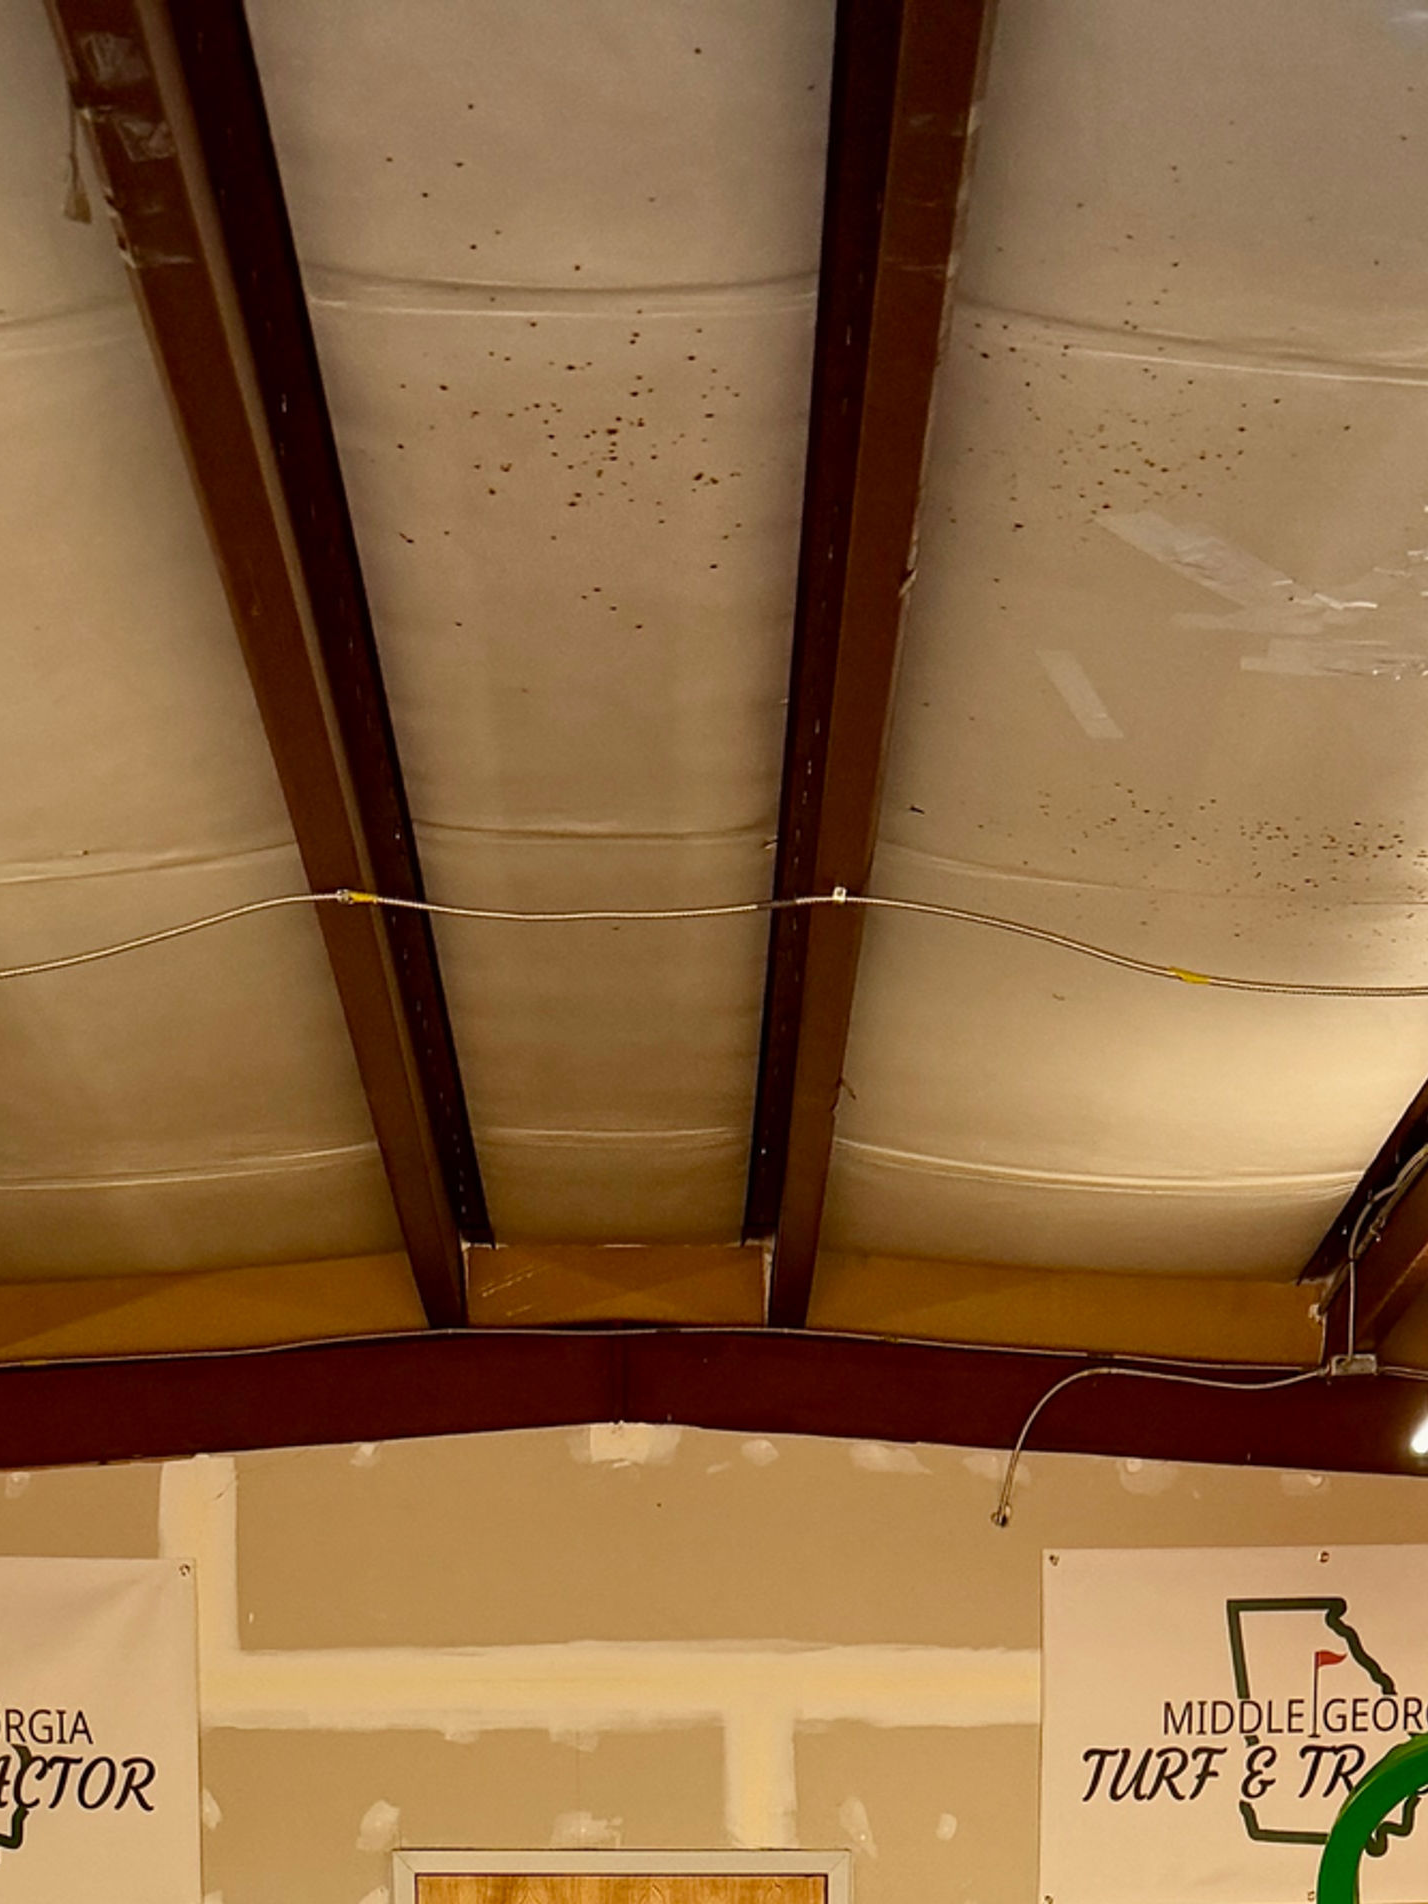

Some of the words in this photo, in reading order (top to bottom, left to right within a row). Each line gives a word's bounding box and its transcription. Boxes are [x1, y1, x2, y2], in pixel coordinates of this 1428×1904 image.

[1162, 1697, 1305, 1736] MIDDLE
[1081, 1746, 1228, 1803] TURF
[1241, 1745, 1277, 1800] &
